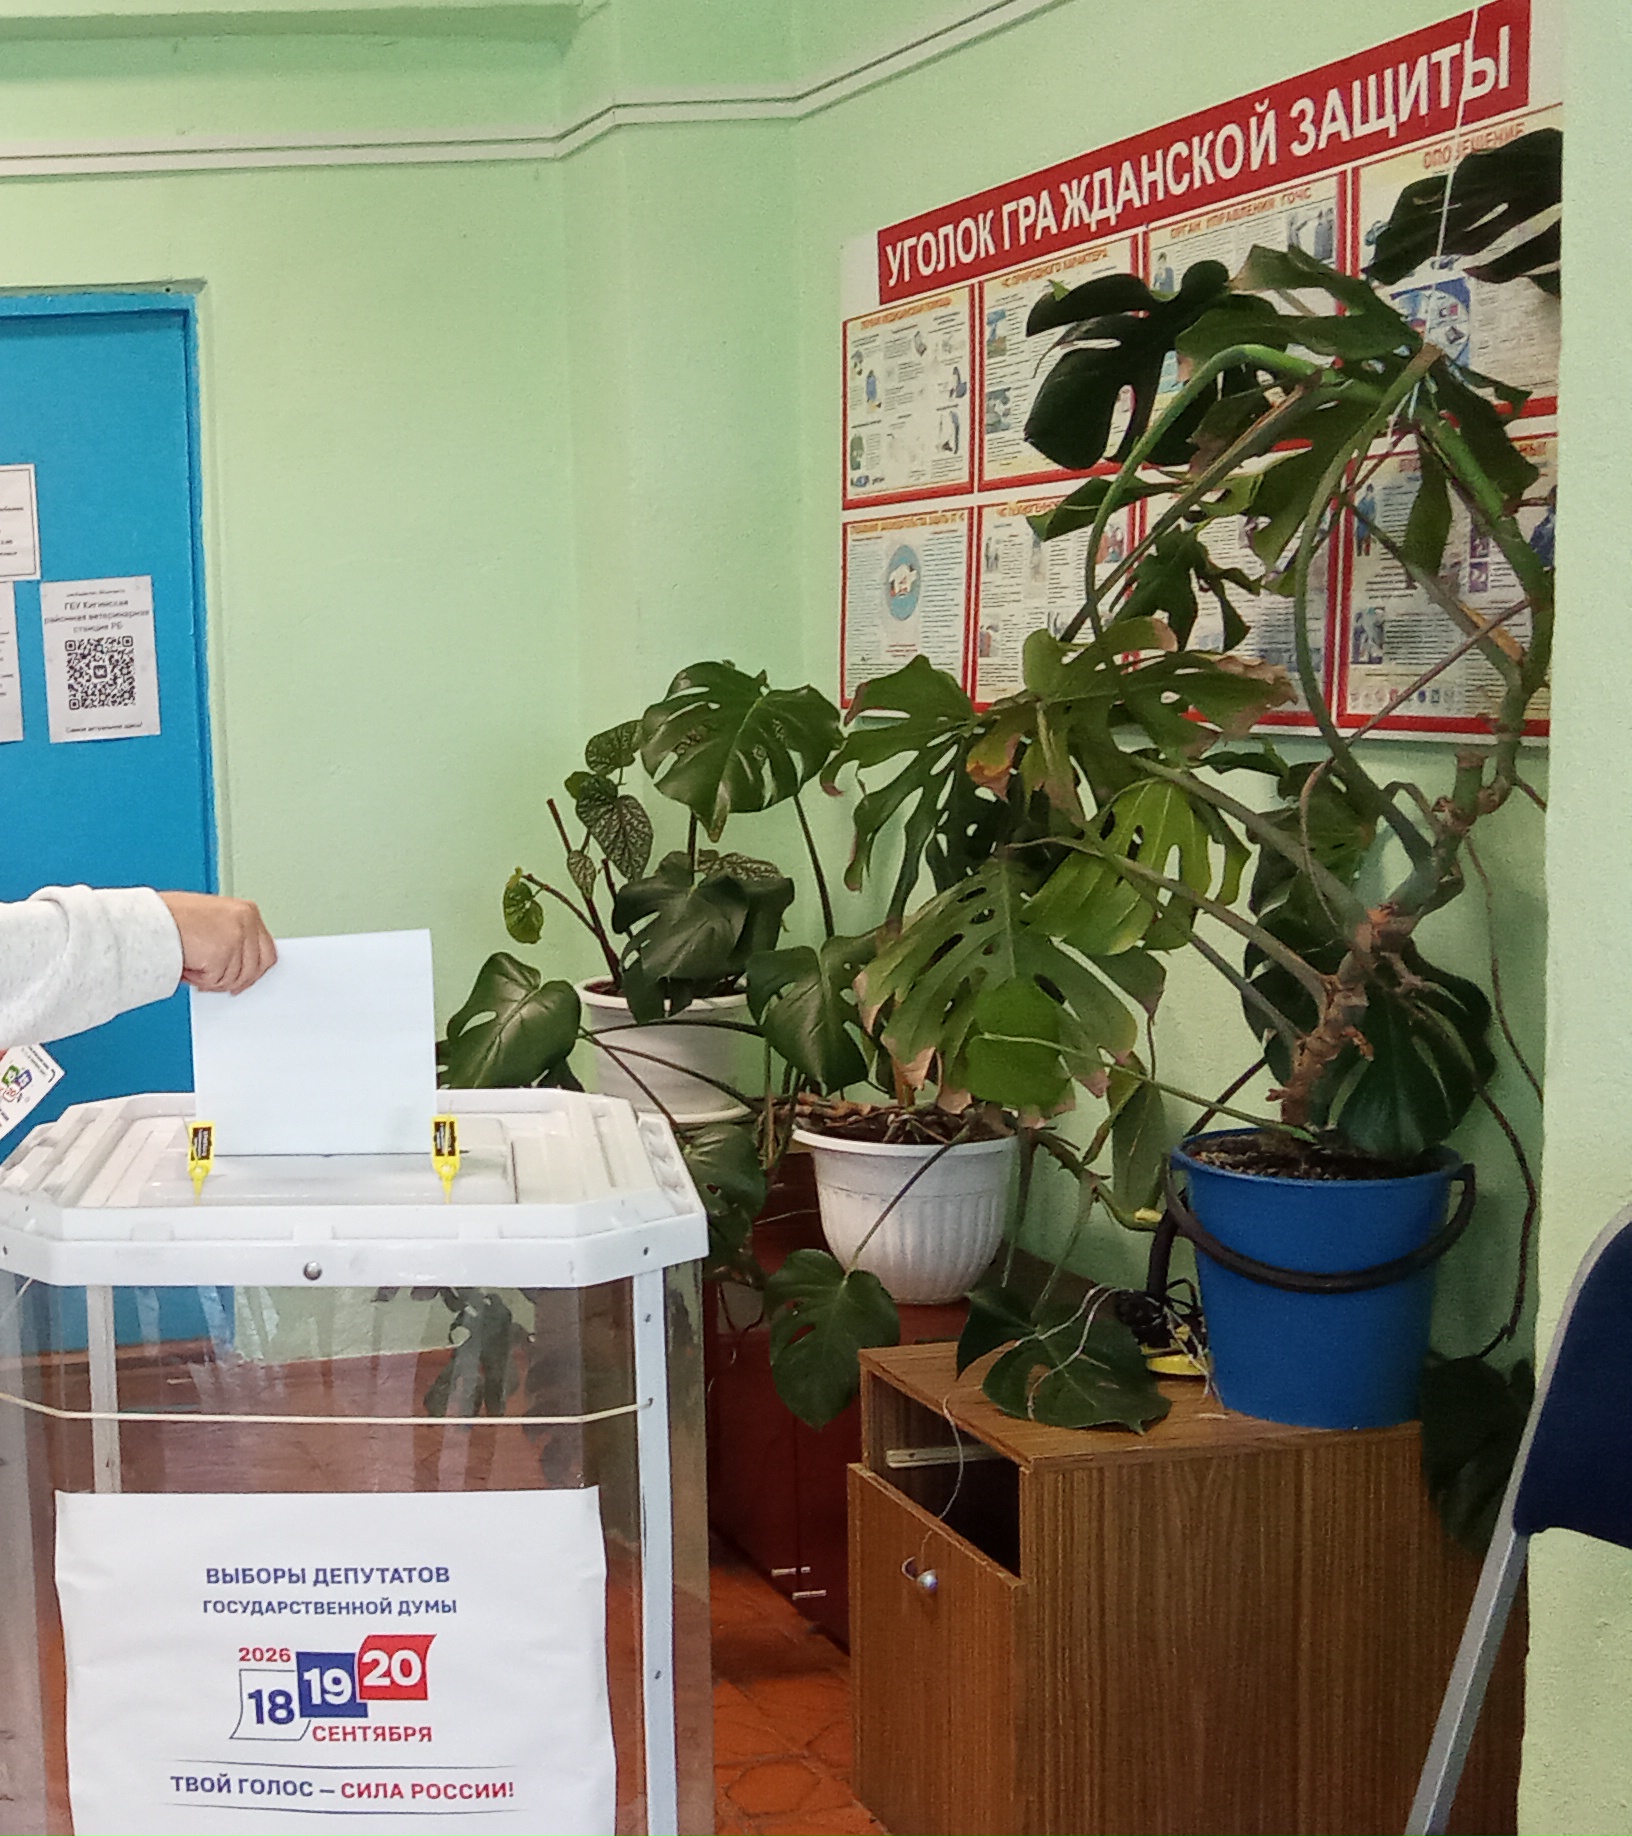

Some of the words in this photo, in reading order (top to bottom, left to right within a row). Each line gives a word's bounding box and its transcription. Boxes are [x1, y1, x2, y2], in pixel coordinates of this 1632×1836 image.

[884, 208, 996, 288] УГОЛОК
[1001, 102, 1278, 250] ГРАЖДАНСКОЙ
[1289, 25, 1511, 155] ЗАЩИТЫ
[205, 1566, 308, 1585] ВЫБОРЫ
[312, 1565, 451, 1588] ДЕПУТАТОВ
[202, 1596, 393, 1616] ГОСУДАРСТВЕННОЙ
[397, 1598, 458, 1618] ДУМЫ
[238, 1647, 292, 1664] 2026
[248, 1688, 296, 1726] 18
[302, 1667, 353, 1706] 19
[361, 1650, 423, 1687] 20
[311, 1725, 433, 1744] СЕНТЯБРЯ
[170, 1774, 233, 1796] ТВОЙ
[238, 1777, 314, 1798] ГОЛОС
[340, 1780, 405, 1800] СИЛА
[410, 1781, 515, 1800] РОССИИ!
